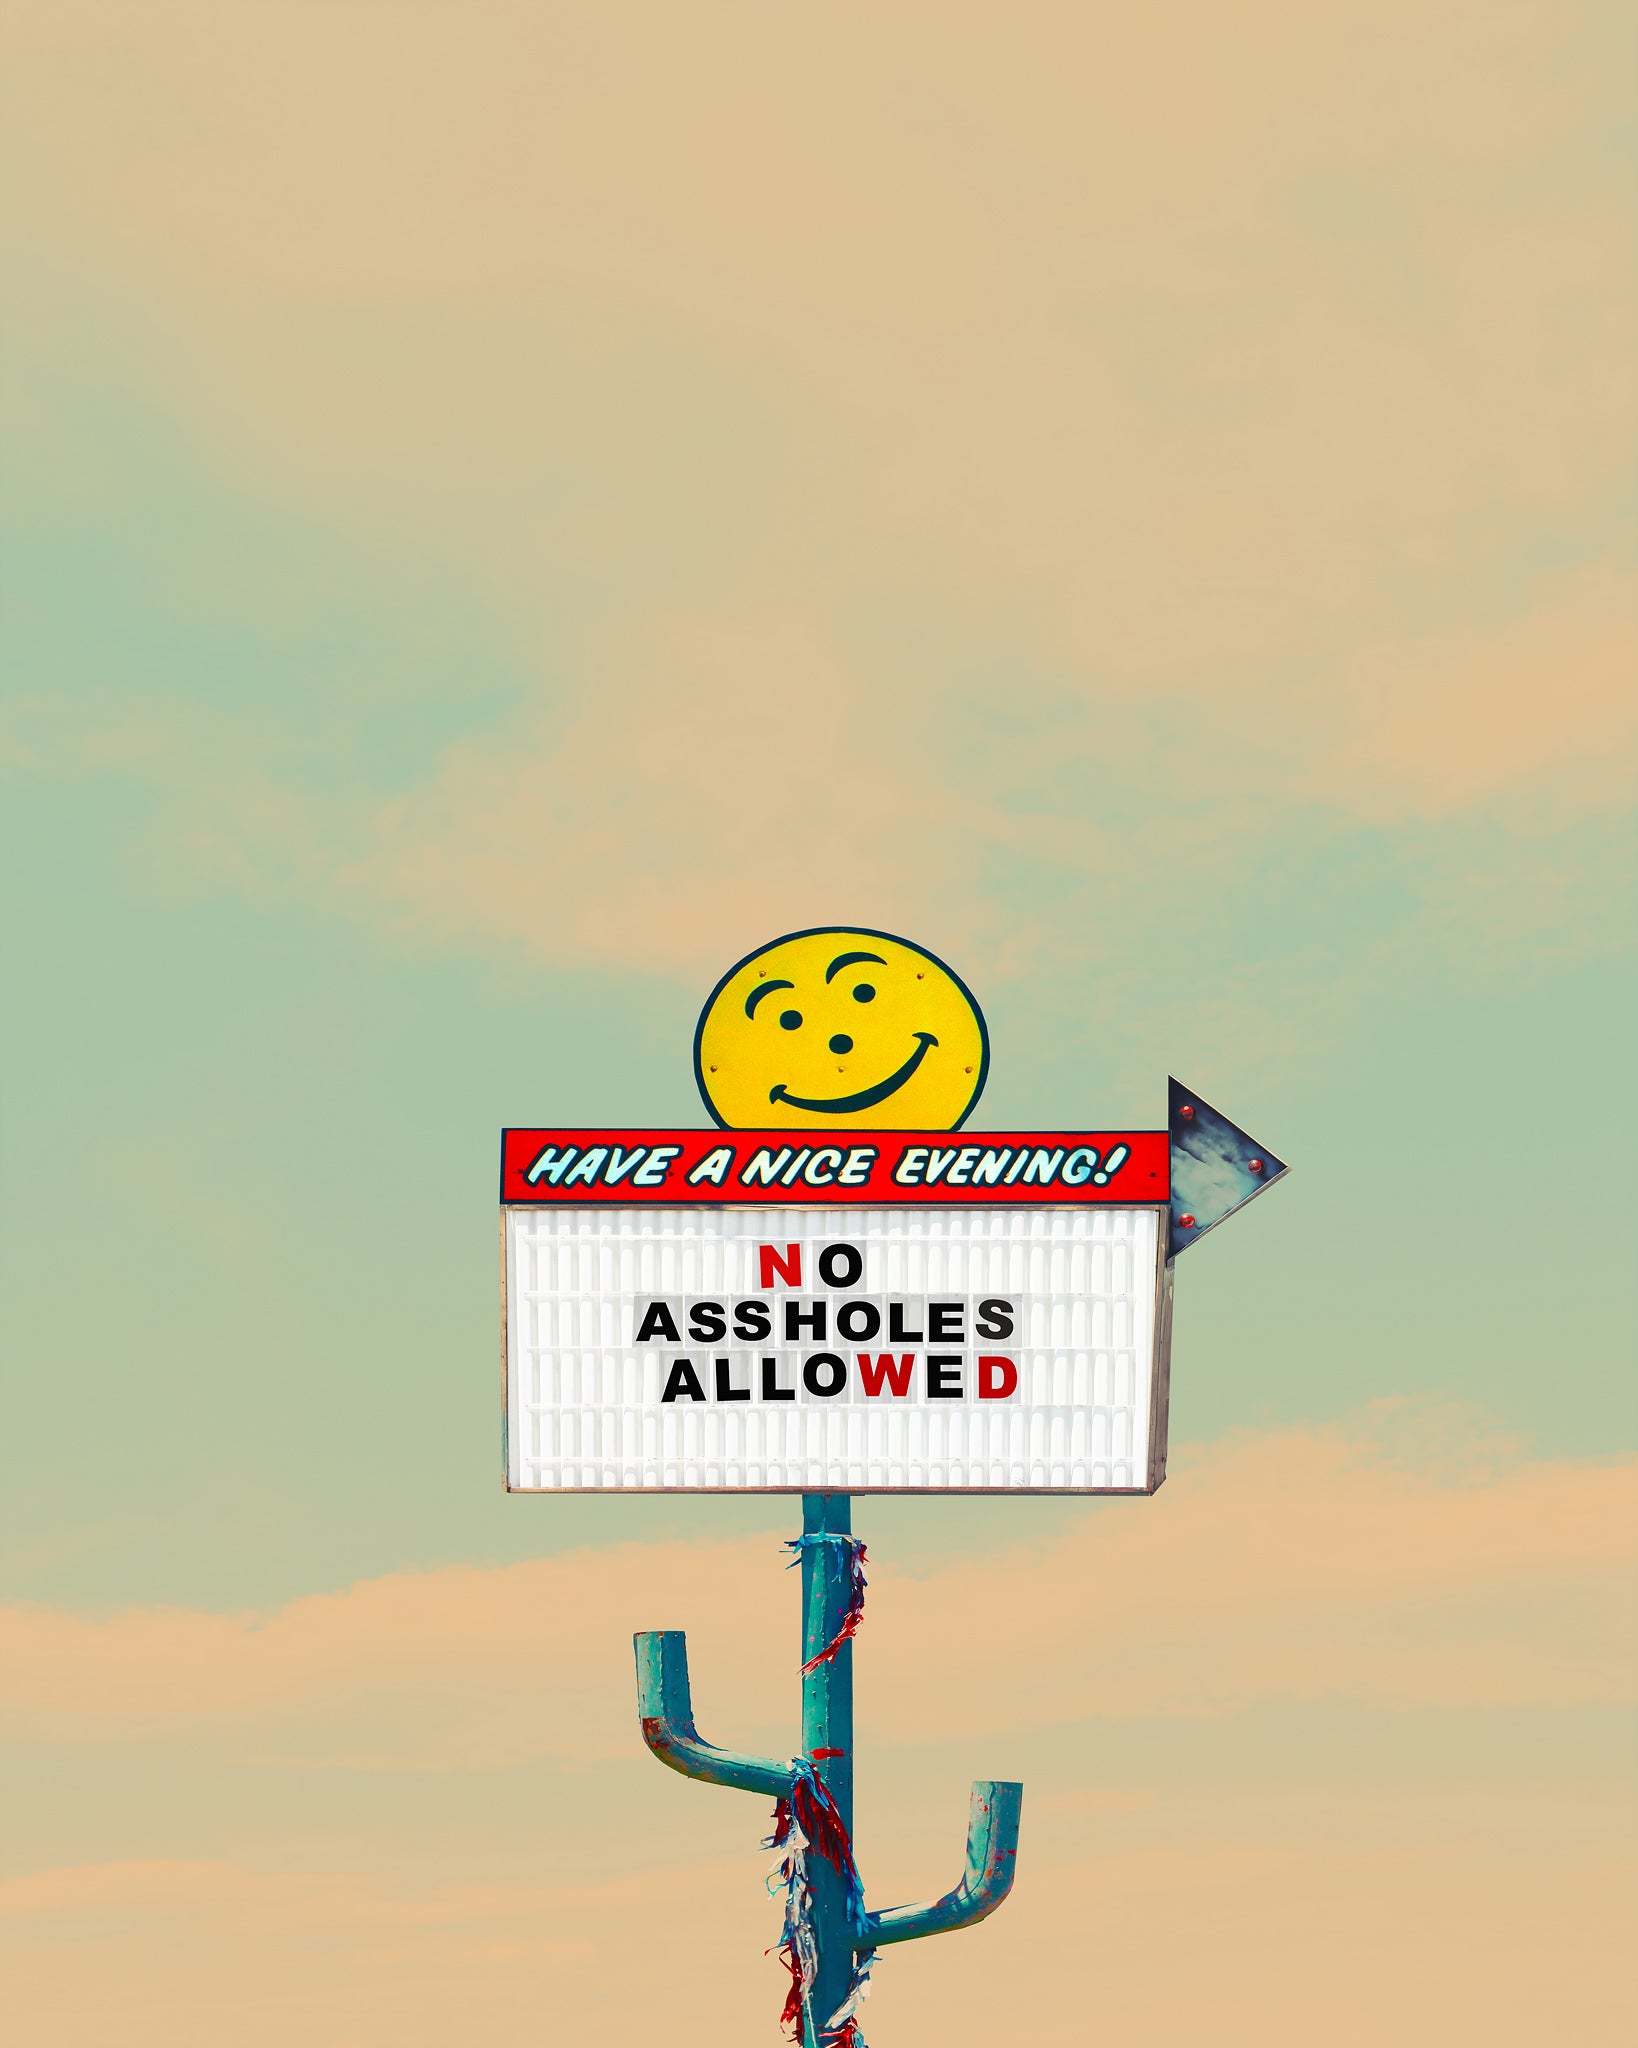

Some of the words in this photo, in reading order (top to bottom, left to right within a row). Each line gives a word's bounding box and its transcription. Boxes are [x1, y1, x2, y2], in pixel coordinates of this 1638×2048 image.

[528, 1148, 679, 1184] HAVE
[690, 1149, 731, 1183] A
[742, 1149, 875, 1184] NICE
[896, 1147, 1126, 1183] EVENING!
[760, 1244, 862, 1288] NO
[636, 1299, 1013, 1342] ASSHOLES
[661, 1353, 1017, 1402] ALLOWED
